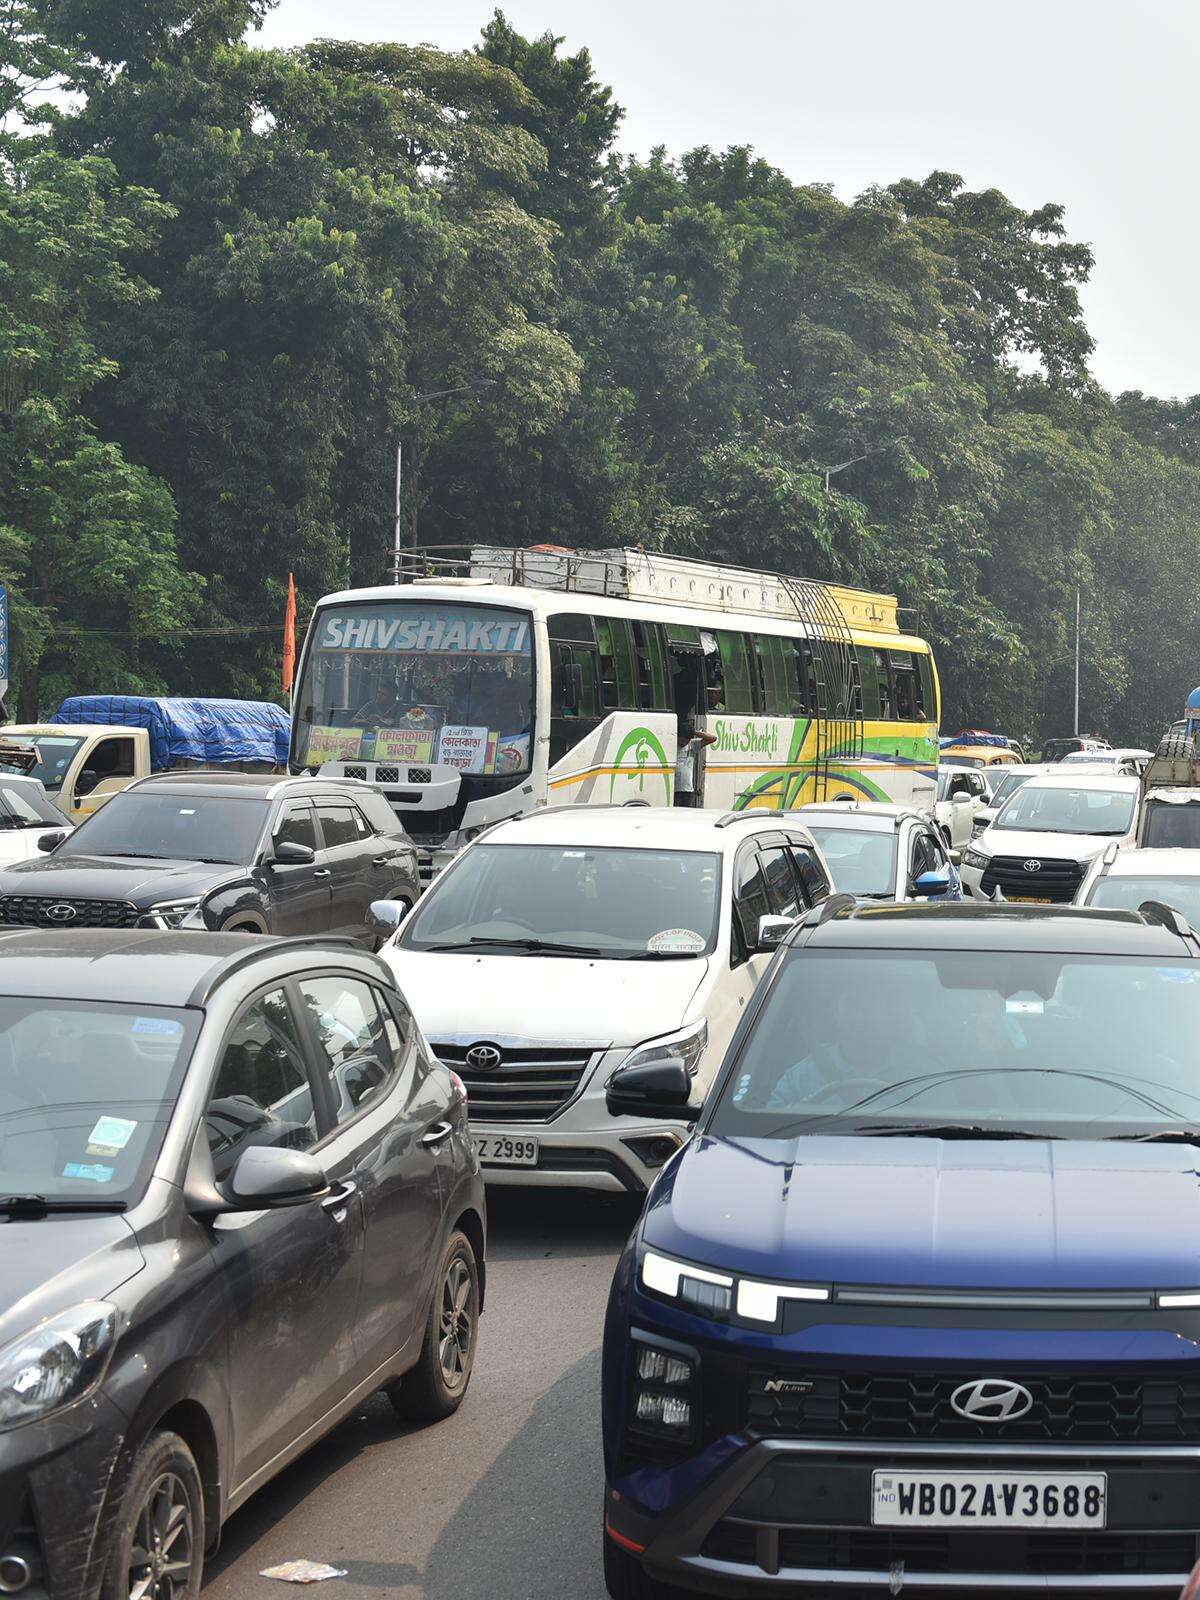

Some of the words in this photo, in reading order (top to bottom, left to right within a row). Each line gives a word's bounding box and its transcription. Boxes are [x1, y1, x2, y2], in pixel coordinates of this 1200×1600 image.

[322, 618, 529, 650] SHIVSHAKTI
[740, 722, 778, 760] Shakti
[493, 1140, 535, 1159] 2999
[878, 1493, 896, 1503] IND
[897, 1482, 1101, 1517] WB02AV3688
